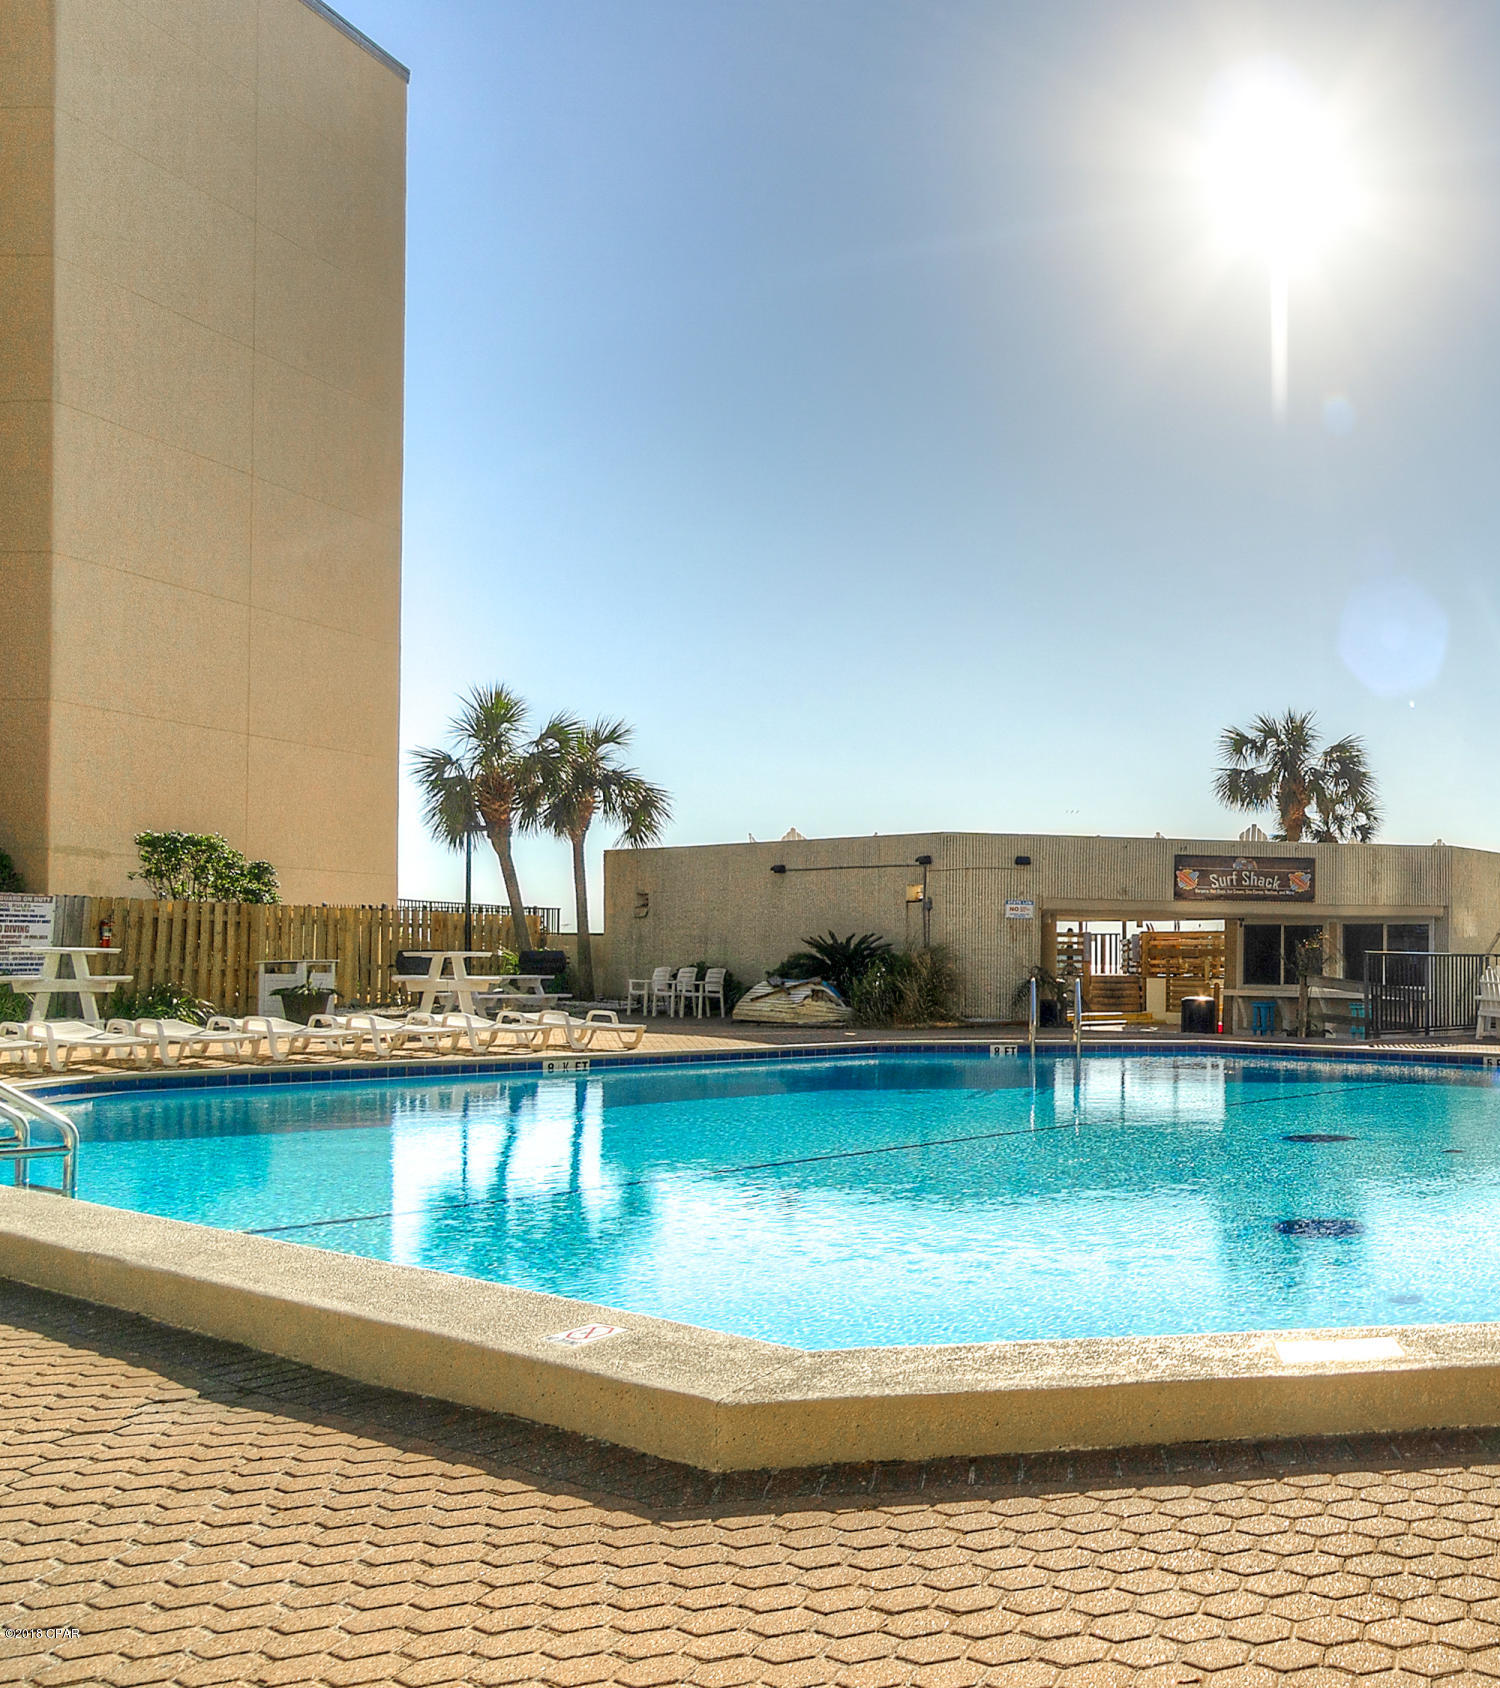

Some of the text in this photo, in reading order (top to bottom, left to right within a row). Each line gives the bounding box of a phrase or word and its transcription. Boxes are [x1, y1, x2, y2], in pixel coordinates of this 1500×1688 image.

[1209, 871, 1281, 889] Surf Shack
[4, 925, 30, 933] DIVING
